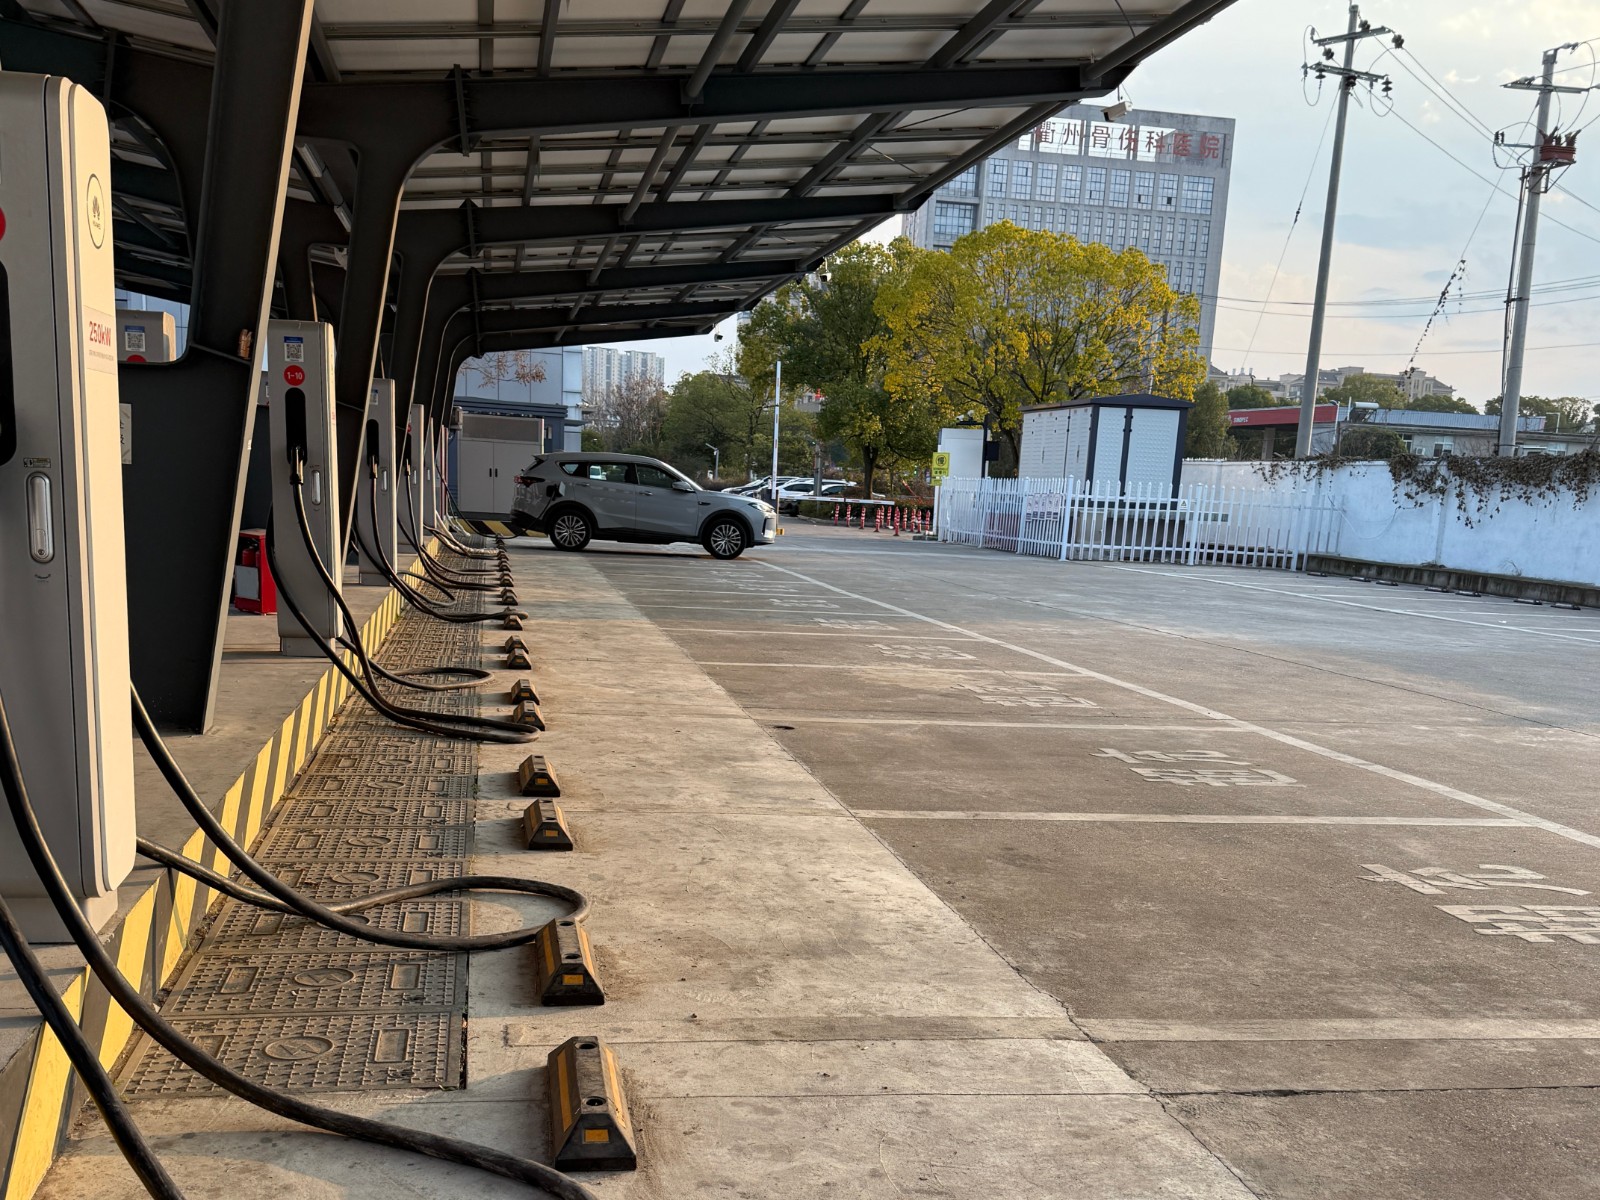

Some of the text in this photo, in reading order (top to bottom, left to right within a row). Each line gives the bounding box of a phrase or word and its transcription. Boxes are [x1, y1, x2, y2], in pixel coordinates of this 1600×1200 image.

[1034, 120, 1220, 159] 衢州骨伤科医院
[89, 321, 112, 347] 250kW
[287, 372, 303, 380] 1-10
